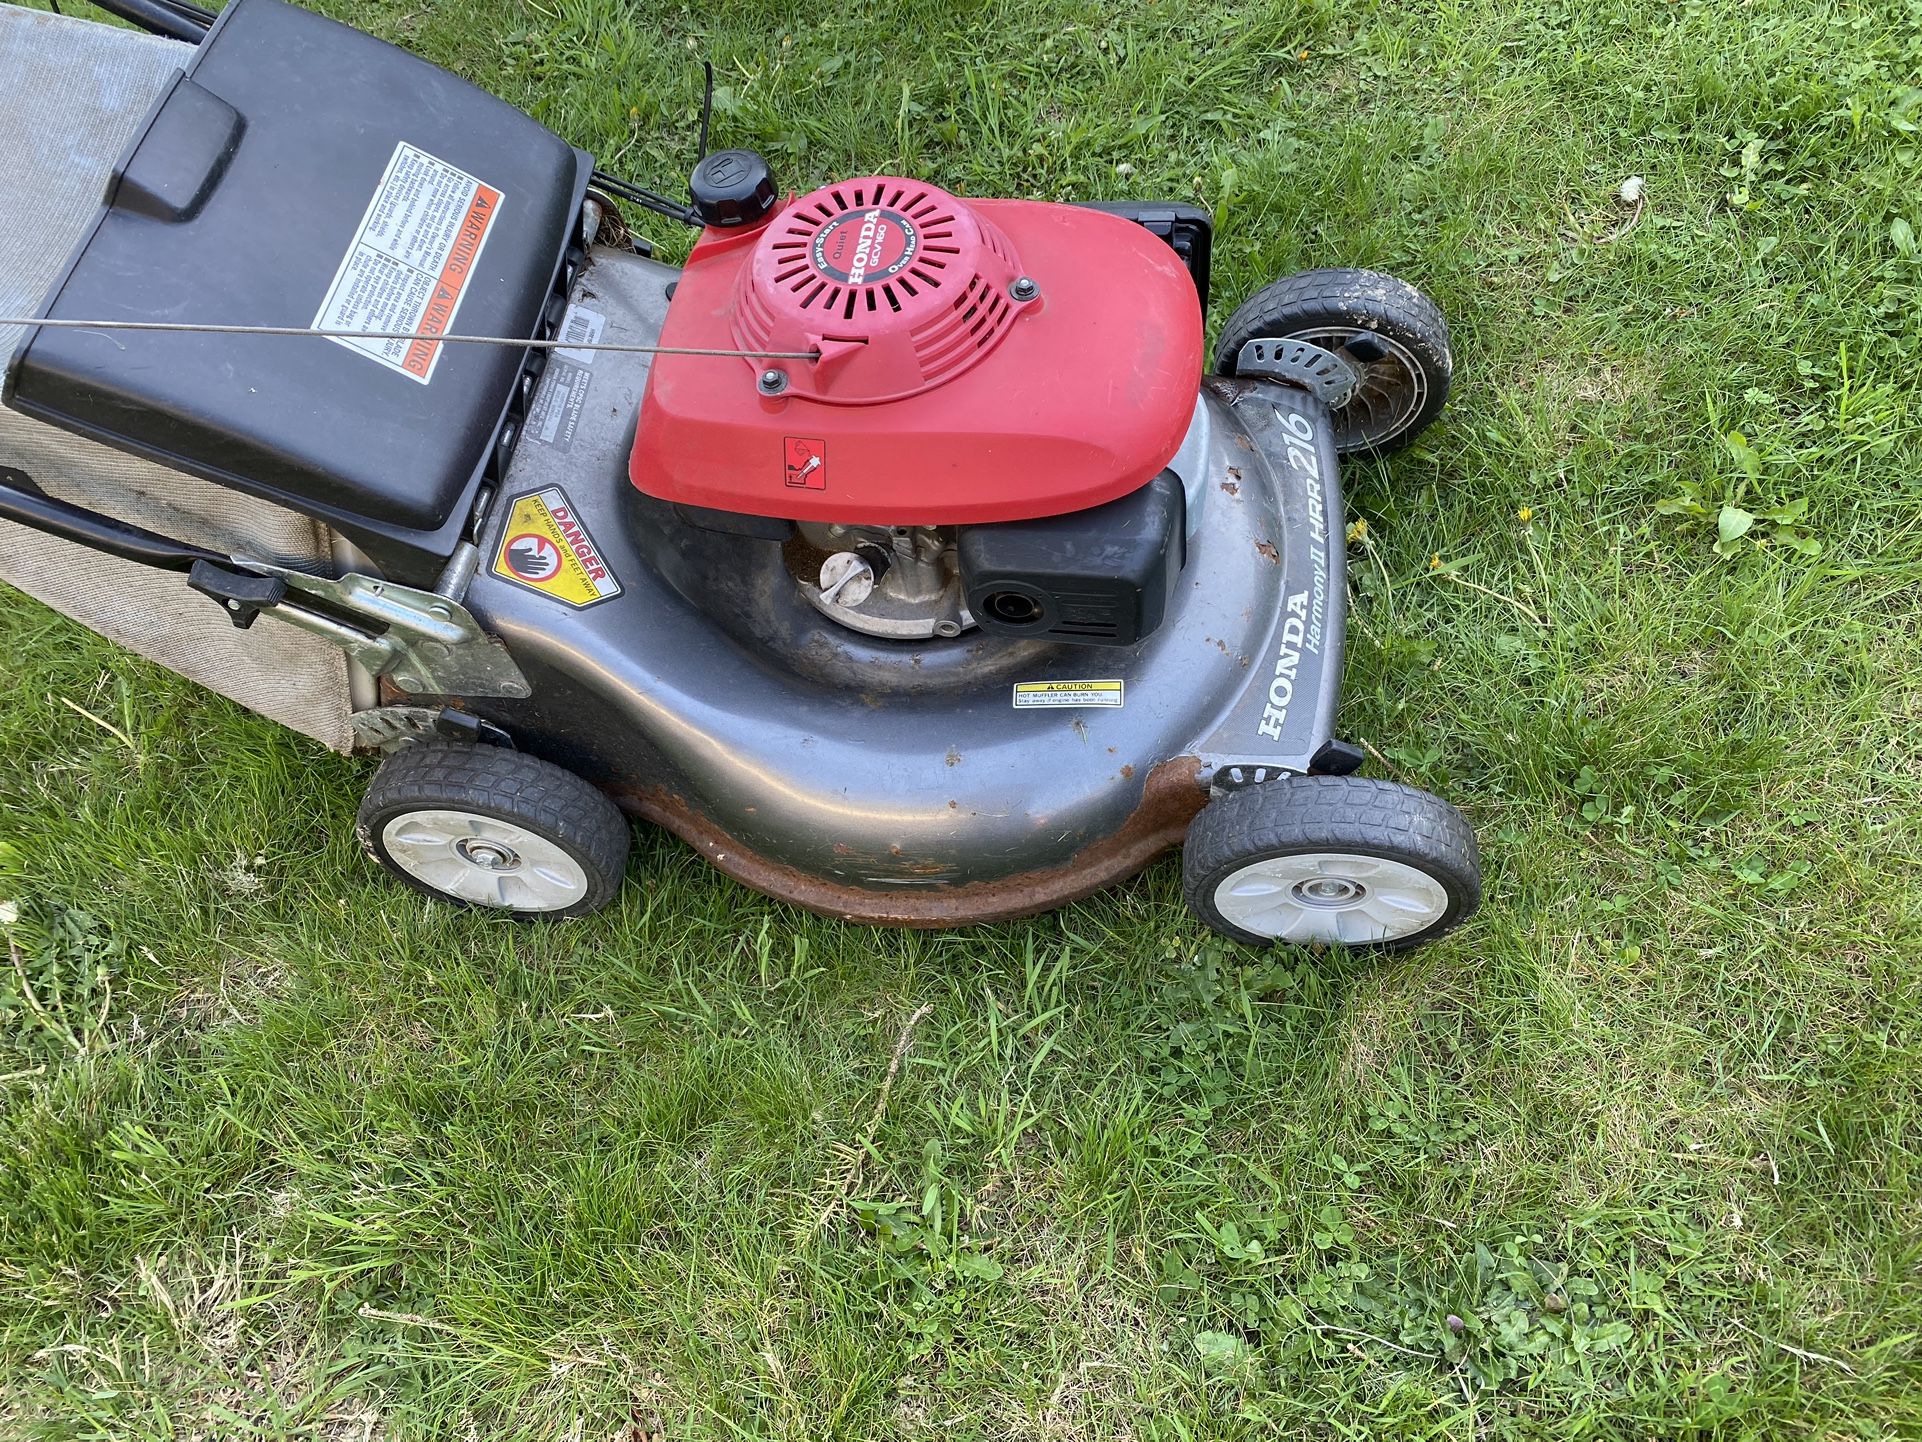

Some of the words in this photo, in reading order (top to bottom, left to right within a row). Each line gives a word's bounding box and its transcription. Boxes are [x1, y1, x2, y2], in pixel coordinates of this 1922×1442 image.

[460, 179, 473, 197] AVOID
[450, 196, 466, 221] SERIOUS
[441, 220, 455, 242] INJURY
[447, 208, 486, 275] WARNING
[833, 231, 848, 259] Quiet
[870, 224, 886, 266] GCV160
[436, 241, 446, 252] OR
[816, 222, 839, 269] Easy-Start
[848, 209, 880, 284] HONDA
[427, 251, 442, 273] DEATH.
[412, 272, 424, 287] CAN
[415, 276, 431, 300] OBJECT
[403, 285, 418, 307] CAUSE
[391, 306, 409, 333] SERIOUS
[404, 299, 421, 327] THROWN
[1272, 405, 1325, 544] HRR216
[530, 498, 548, 518] KEEP
[543, 518, 563, 543] HANDS
[558, 543, 572, 557] and
[567, 557, 583, 576] FEET
[579, 576, 597, 597] AWAY
[550, 506, 608, 581] DANGER
[1257, 590, 1309, 742] HONDA
